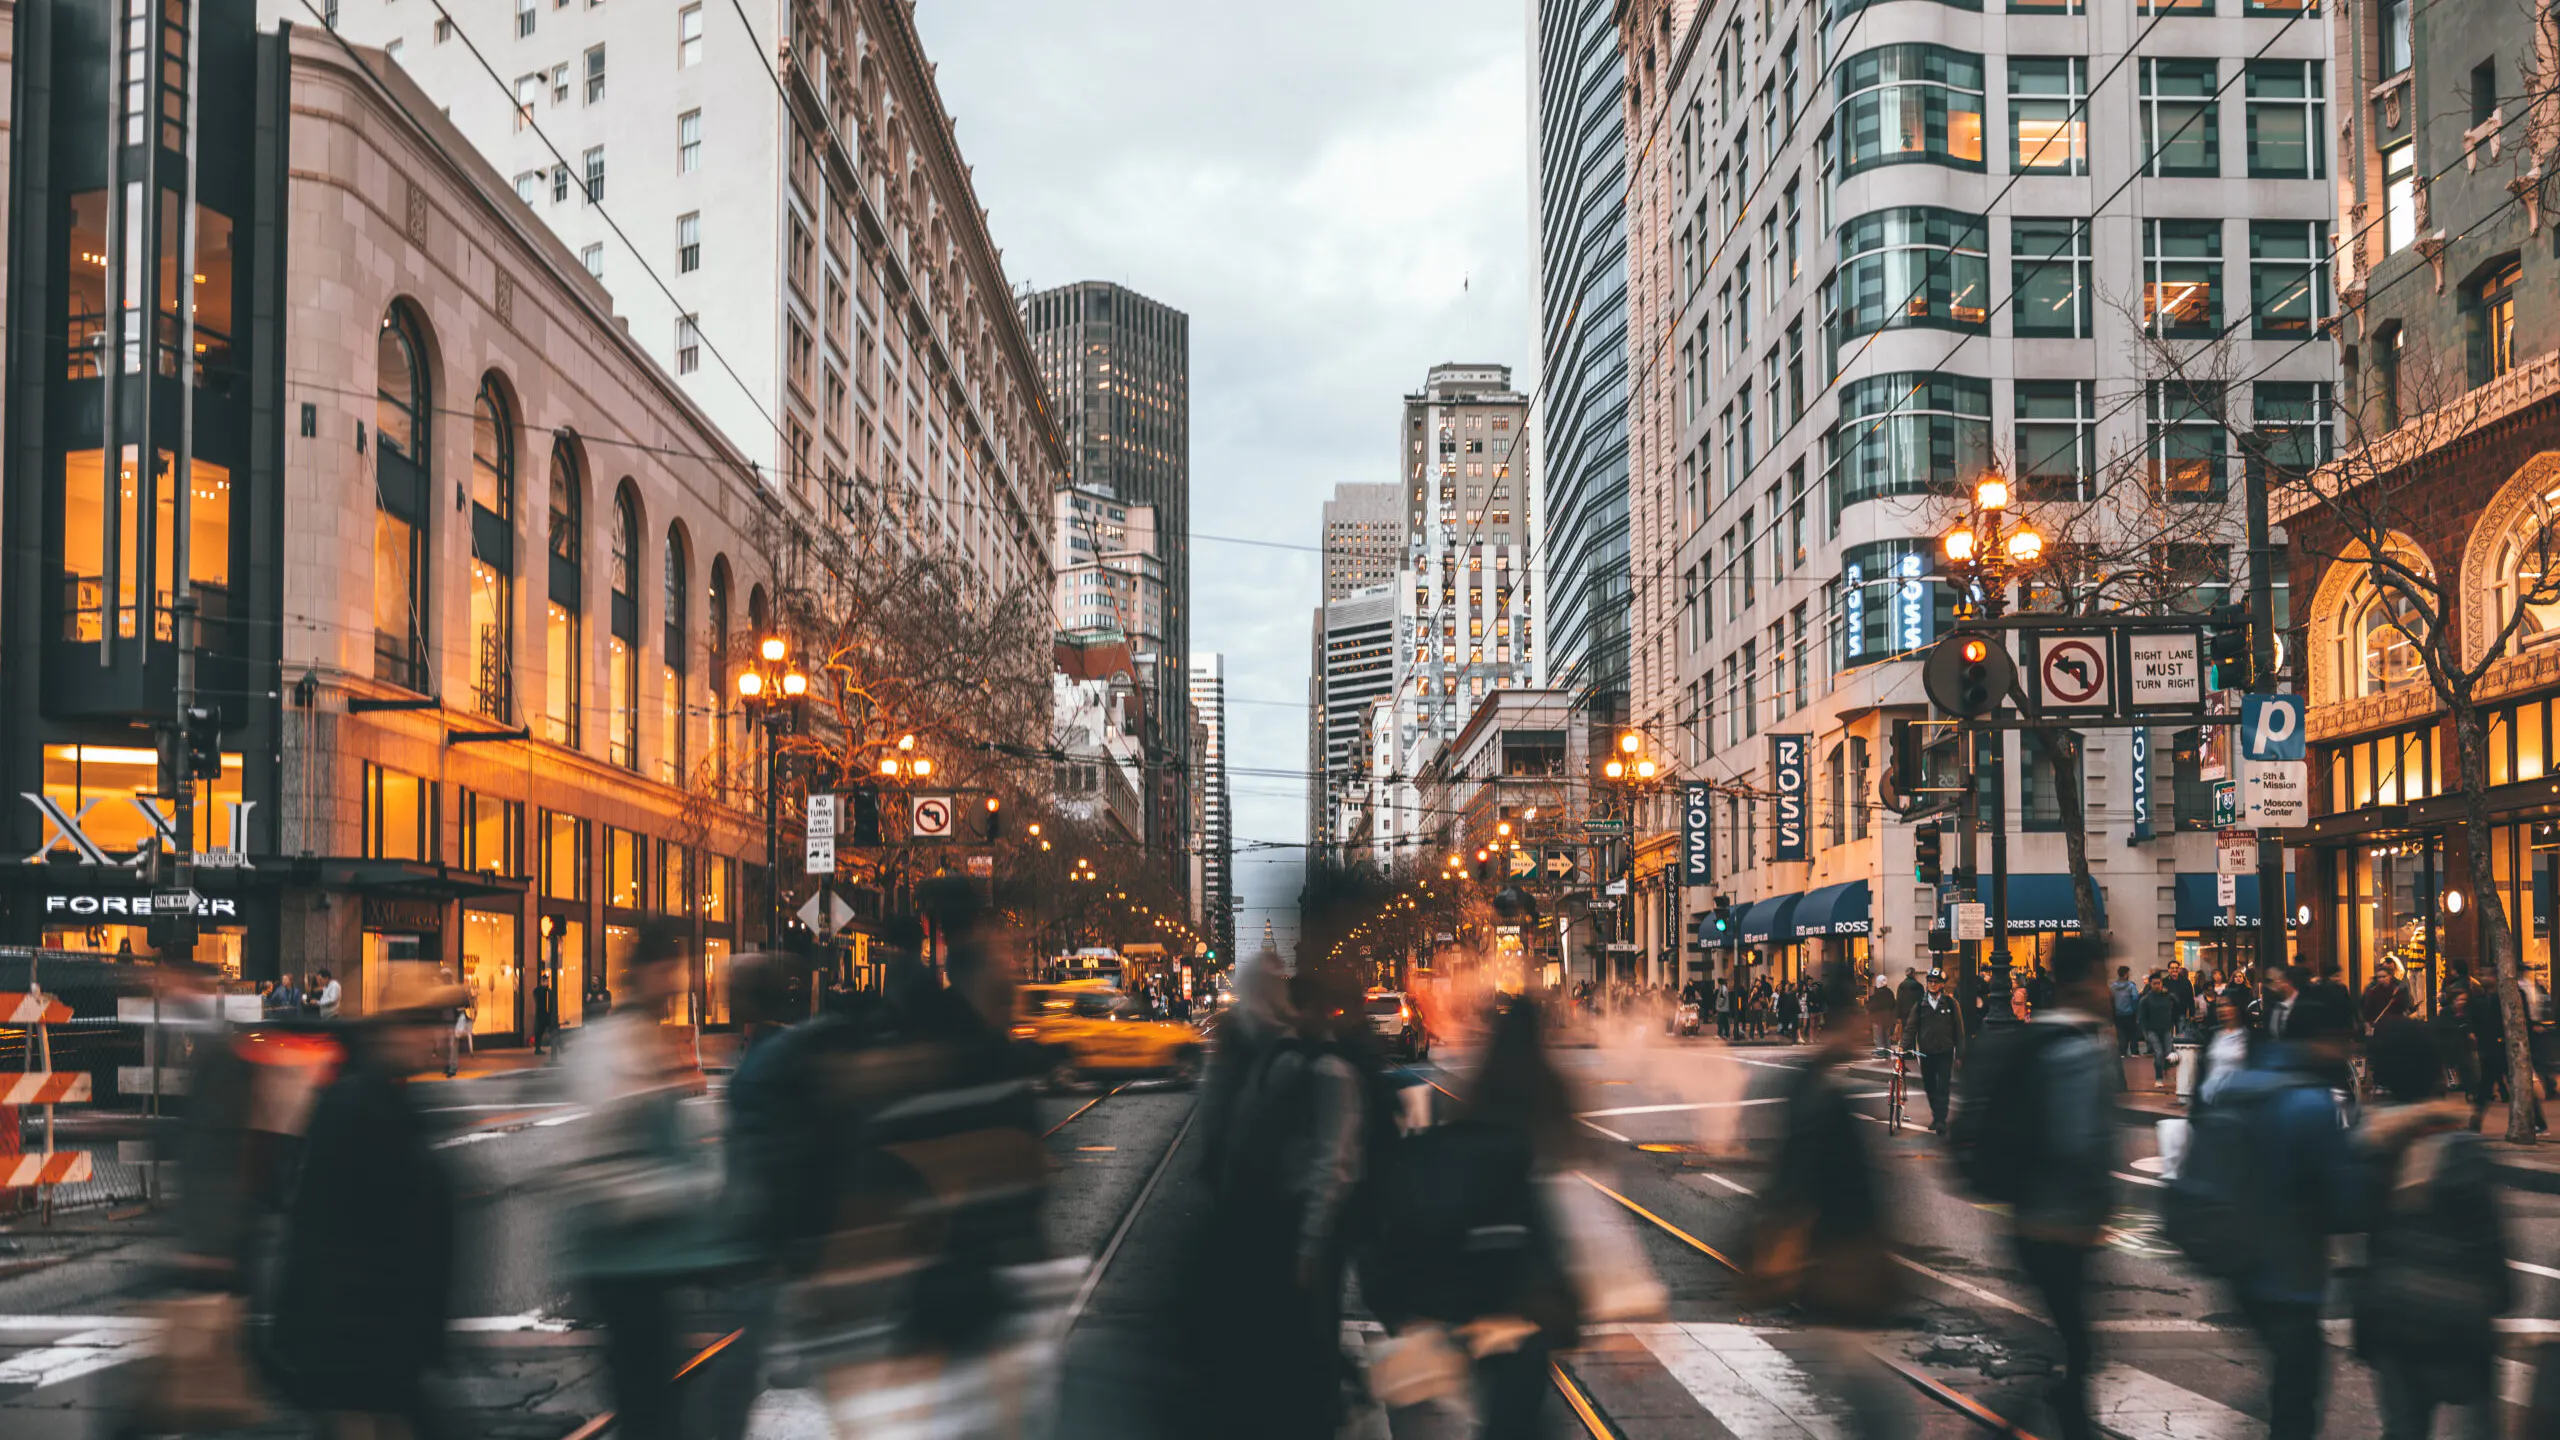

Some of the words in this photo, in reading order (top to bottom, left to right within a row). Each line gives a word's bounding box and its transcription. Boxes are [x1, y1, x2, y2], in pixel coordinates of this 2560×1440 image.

[1902, 555, 1922, 650] ROSS
[2134, 651, 2162, 661] RIGHT
[2168, 650, 2194, 660] LANE
[2146, 663, 2183, 676] MUST
[2136, 680, 2161, 689] TURN
[2168, 679, 2195, 688] RIGHT
[2133, 714, 2145, 824] OSS
[2263, 772, 2277, 780] 5th
[2278, 772, 2286, 780] &
[2263, 781, 2297, 789] Mission
[1778, 741, 1801, 846] ROSS
[815, 798, 827, 807] NO
[2264, 799, 2303, 808] Moscone
[810, 809, 832, 817] TURNS
[2264, 808, 2293, 817] Center
[1688, 787, 1706, 873] ROSS
[2230, 839, 2255, 847] STOPPING
[2230, 858, 2246, 866] TIME
[1835, 921, 1869, 933] ROSS
[2039, 919, 2058, 928] FOR
